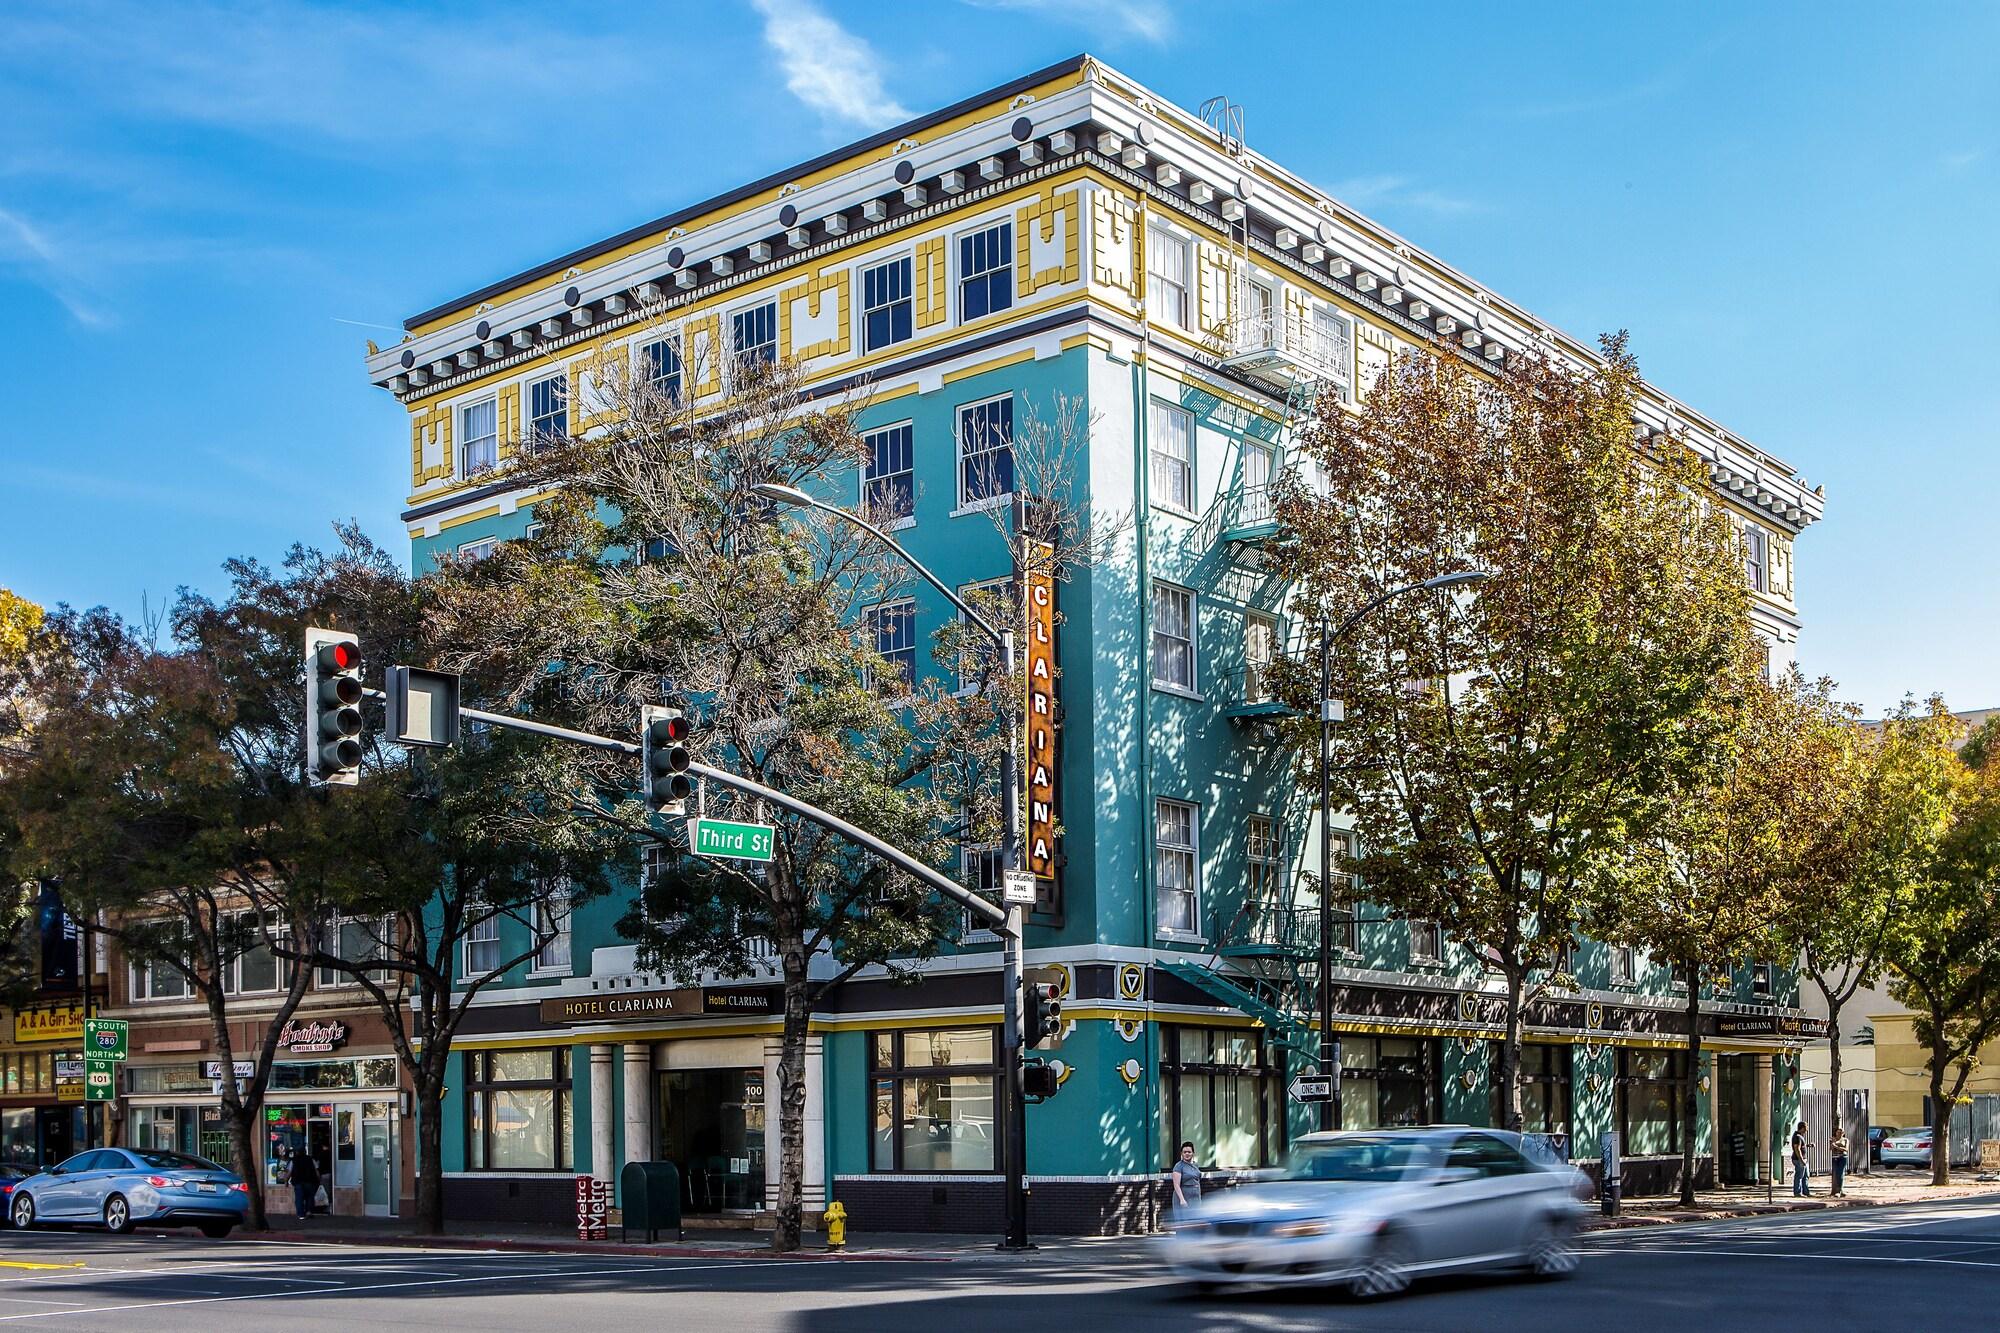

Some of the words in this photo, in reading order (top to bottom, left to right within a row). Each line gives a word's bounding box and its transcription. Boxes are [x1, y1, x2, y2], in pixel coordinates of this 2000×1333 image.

[1034, 585, 1049, 860] CLARIANA
[701, 828, 744, 849] Third
[751, 834, 769, 852] St
[1014, 884, 1027, 892] ZONE
[566, 1001, 605, 1015] HOTEL
[609, 997, 673, 1013] CLARIANA
[708, 995, 727, 1006] Hotel
[728, 995, 768, 1007] CLARIANA
[20, 1015, 27, 1030] A
[30, 1014, 37, 1028] &
[40, 1014, 47, 1028] A
[49, 1013, 66, 1027] GIFT
[68, 1012, 84, 1026] SHO
[97, 1022, 127, 1030] SOUTH
[1720, 1023, 1736, 1031] Hotel
[1737, 1021, 1772, 1031] CLARIANA
[1784, 1022, 1802, 1032] HOTEL
[276, 1020, 345, 1047] Houdini's
[99, 1037, 115, 1045] 280
[86, 1050, 114, 1059] NORTH
[67, 1061, 84, 1070] LAPTO
[93, 1075, 107, 1083] 101
[745, 1086, 763, 1096] 100
[1301, 1084, 1314, 1094] ONE
[1315, 1083, 1327, 1093] WAY
[577, 1178, 588, 1230] Metro
[587, 1179, 606, 1230] Metro
